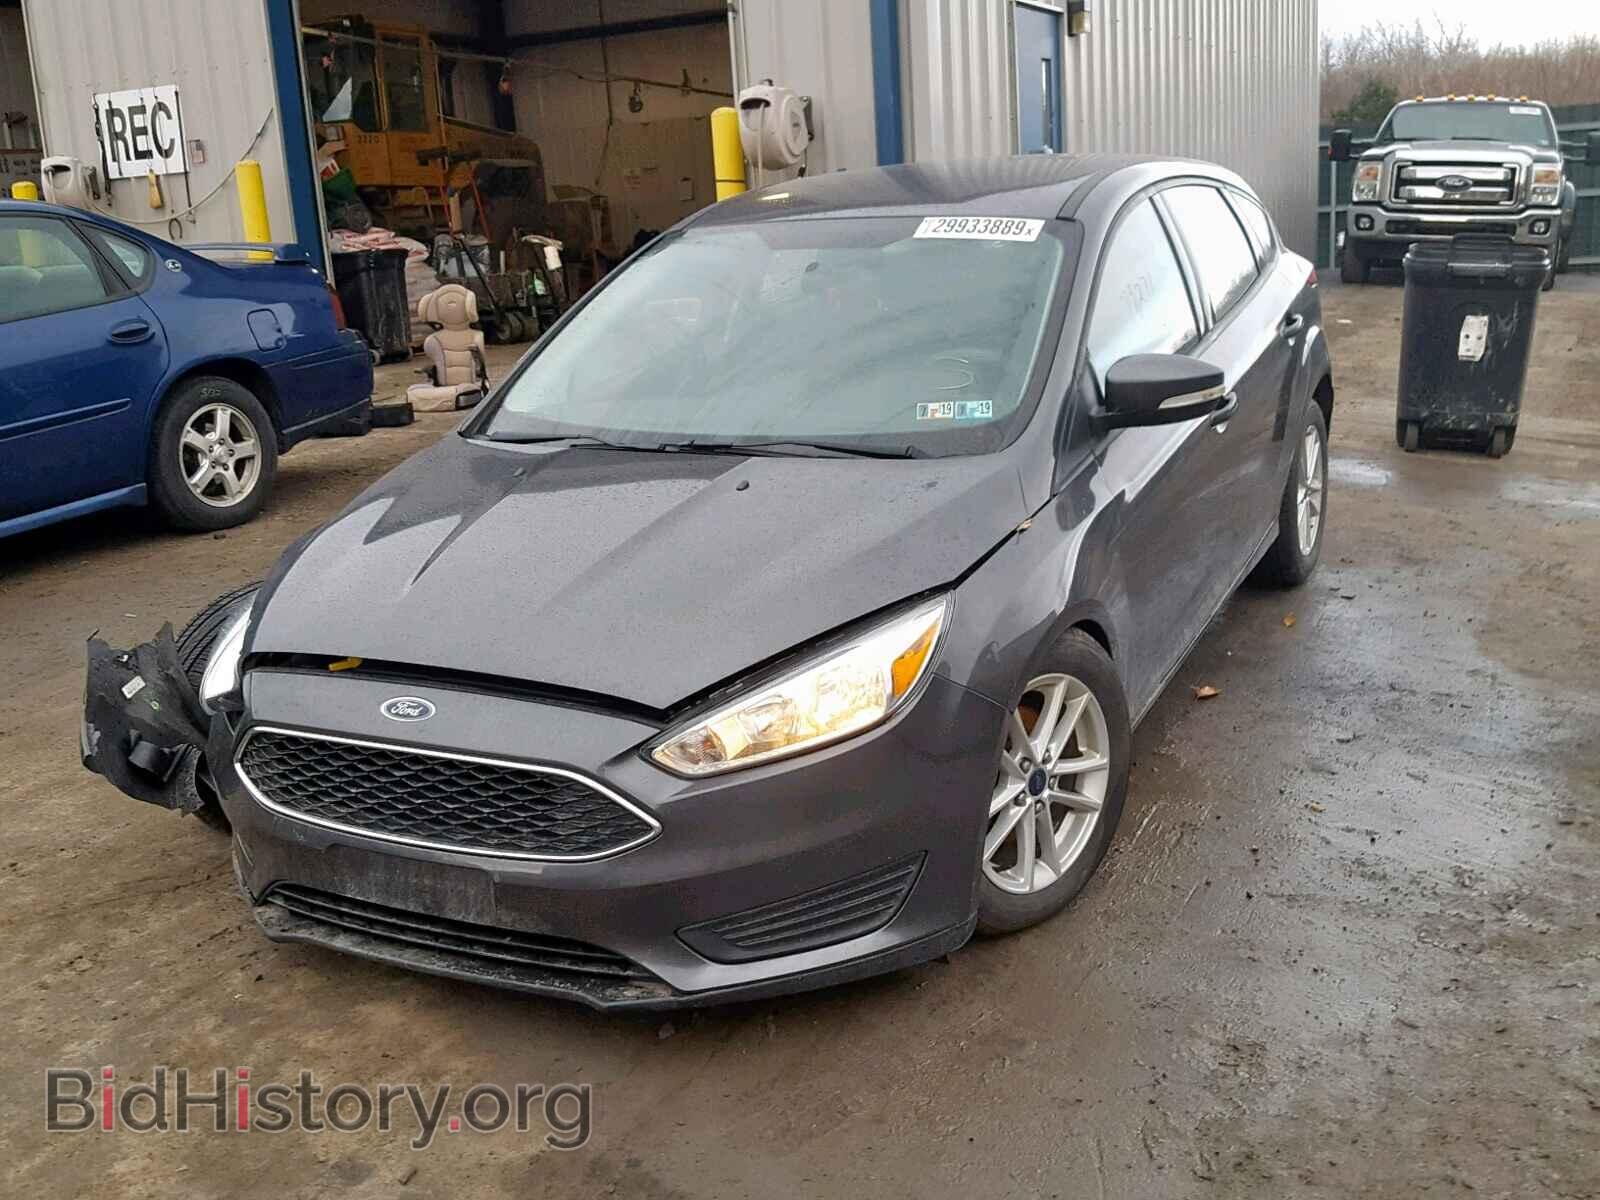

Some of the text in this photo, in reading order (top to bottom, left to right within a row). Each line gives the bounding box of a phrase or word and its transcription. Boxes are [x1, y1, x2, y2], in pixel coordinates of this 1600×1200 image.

[105, 102, 175, 162] REC
[980, 402, 991, 414] 19
[390, 701, 423, 716] Ford
